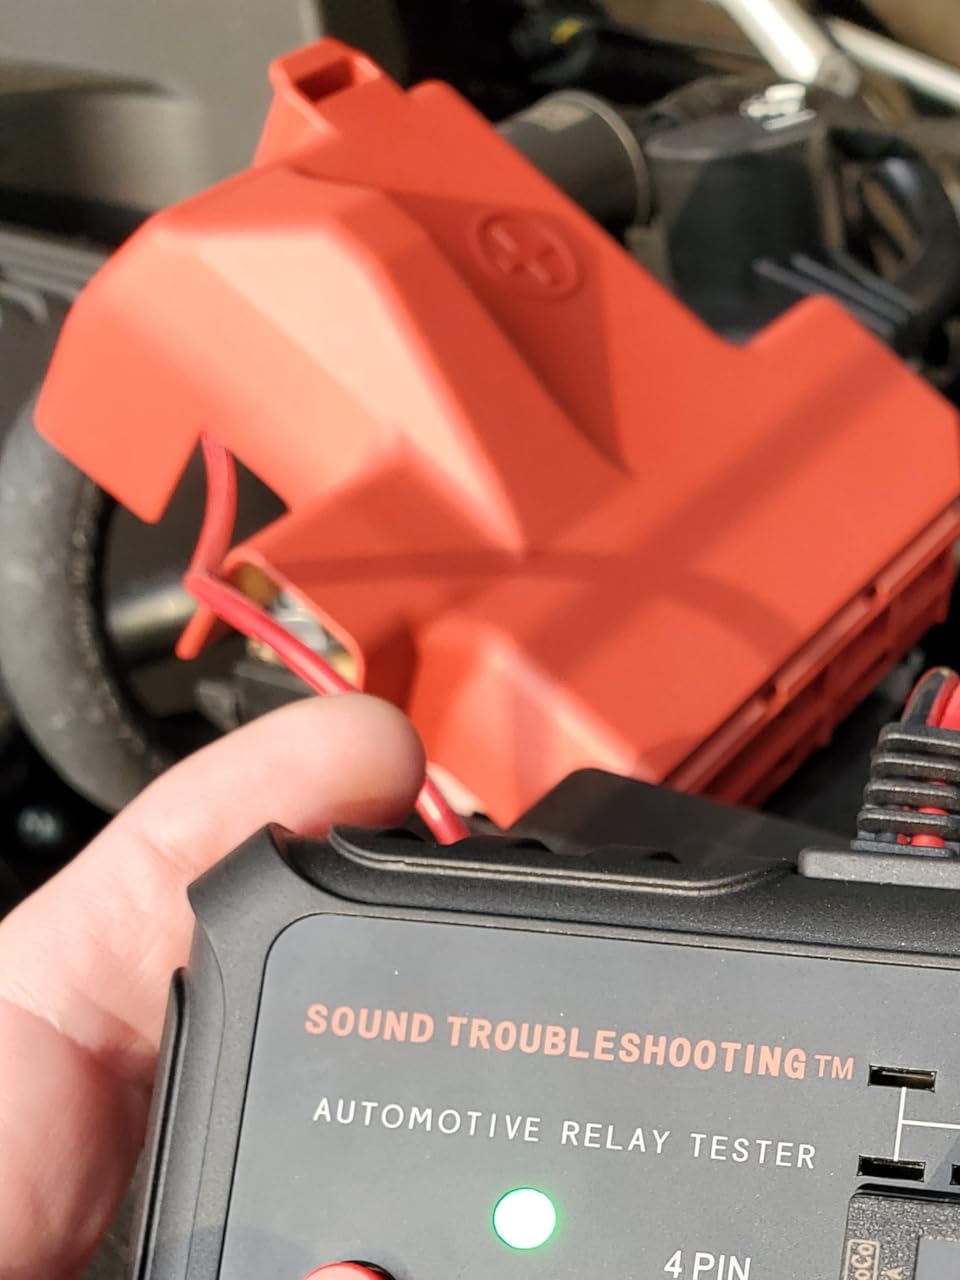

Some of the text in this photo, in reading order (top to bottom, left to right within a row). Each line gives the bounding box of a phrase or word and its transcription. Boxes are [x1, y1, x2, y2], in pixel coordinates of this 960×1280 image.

[304, 1003, 435, 1044] SOUND
[312, 1096, 818, 1170] AUTOMOTIVE RELAY TESTER
[662, 1249, 684, 1280] 4
